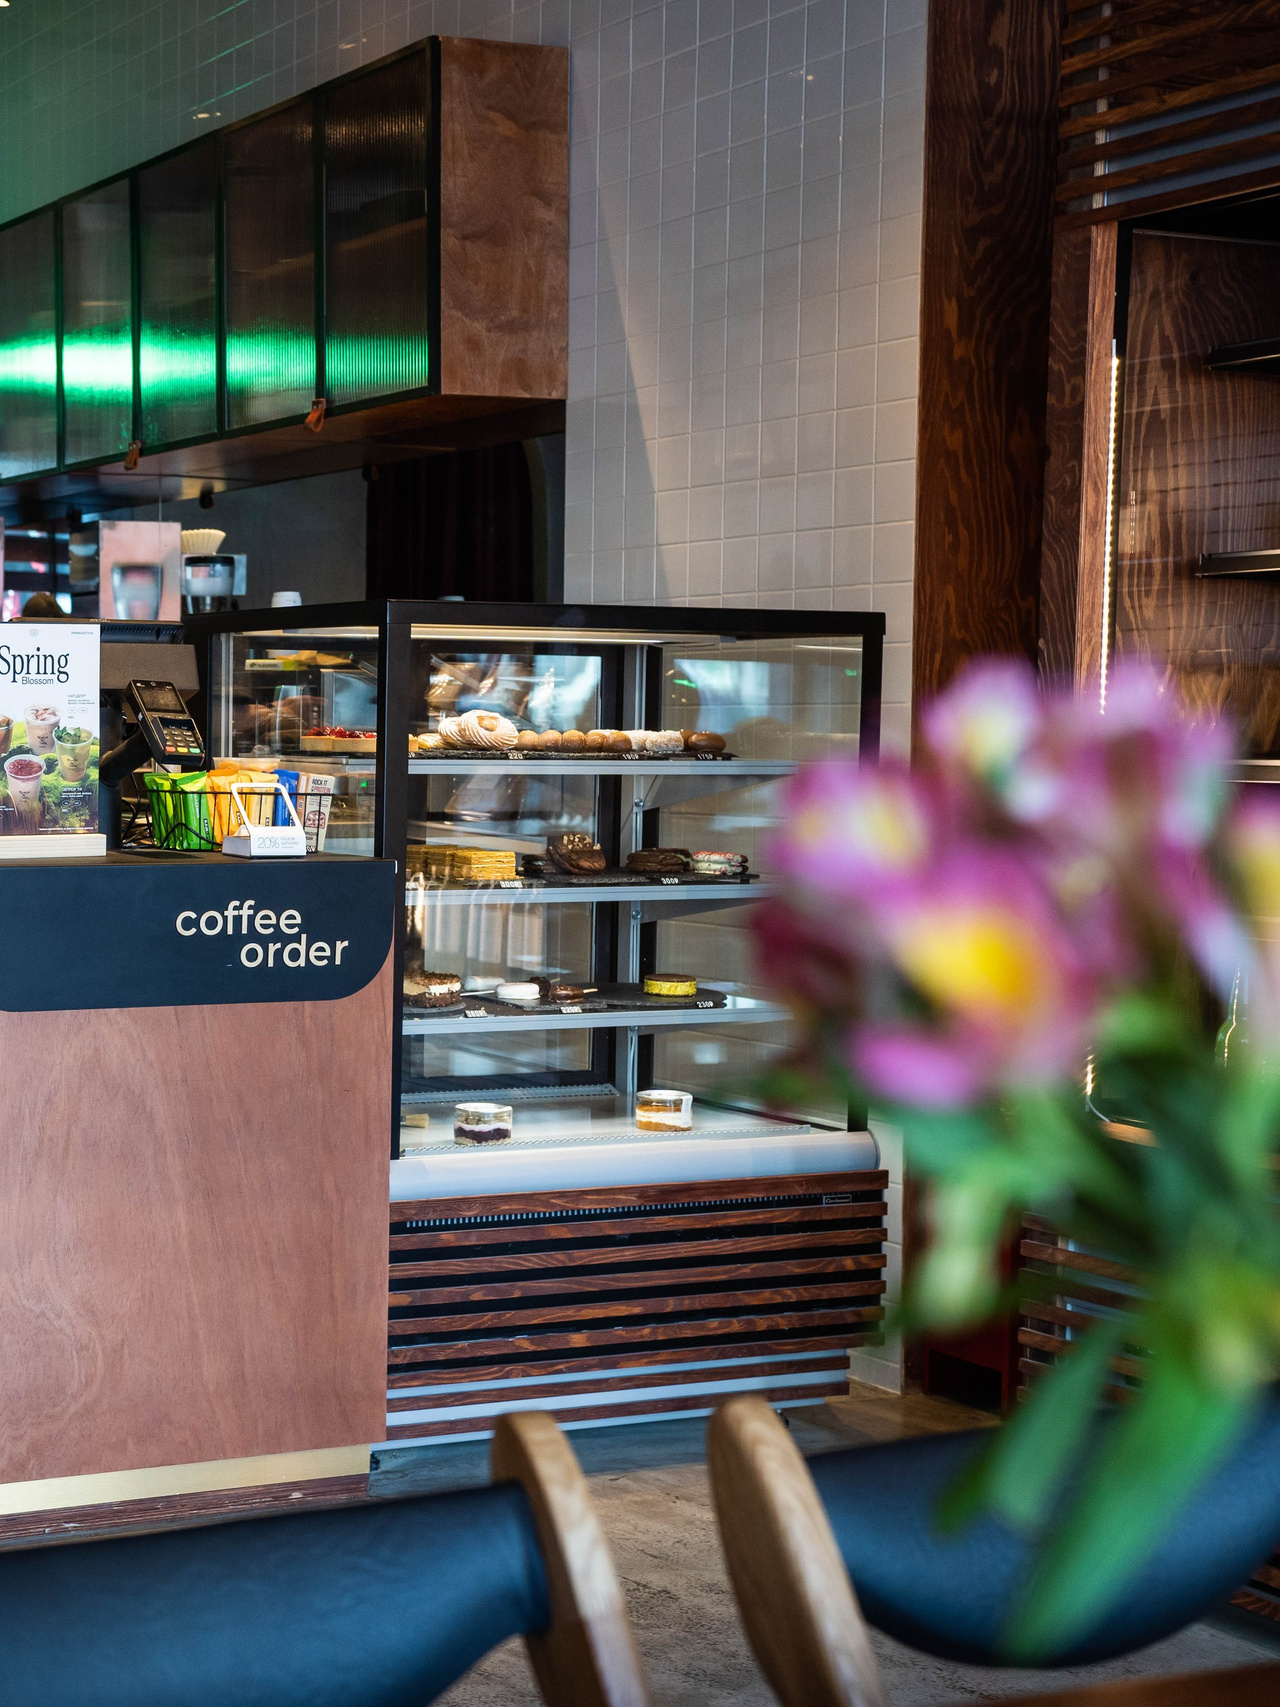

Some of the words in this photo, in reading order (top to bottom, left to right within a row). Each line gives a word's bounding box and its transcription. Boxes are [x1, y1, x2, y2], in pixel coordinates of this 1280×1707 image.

[21, 676, 54, 685] Blossom
[257, 836, 280, 849] 20%
[175, 899, 302, 937] coffee
[239, 934, 350, 969] order
